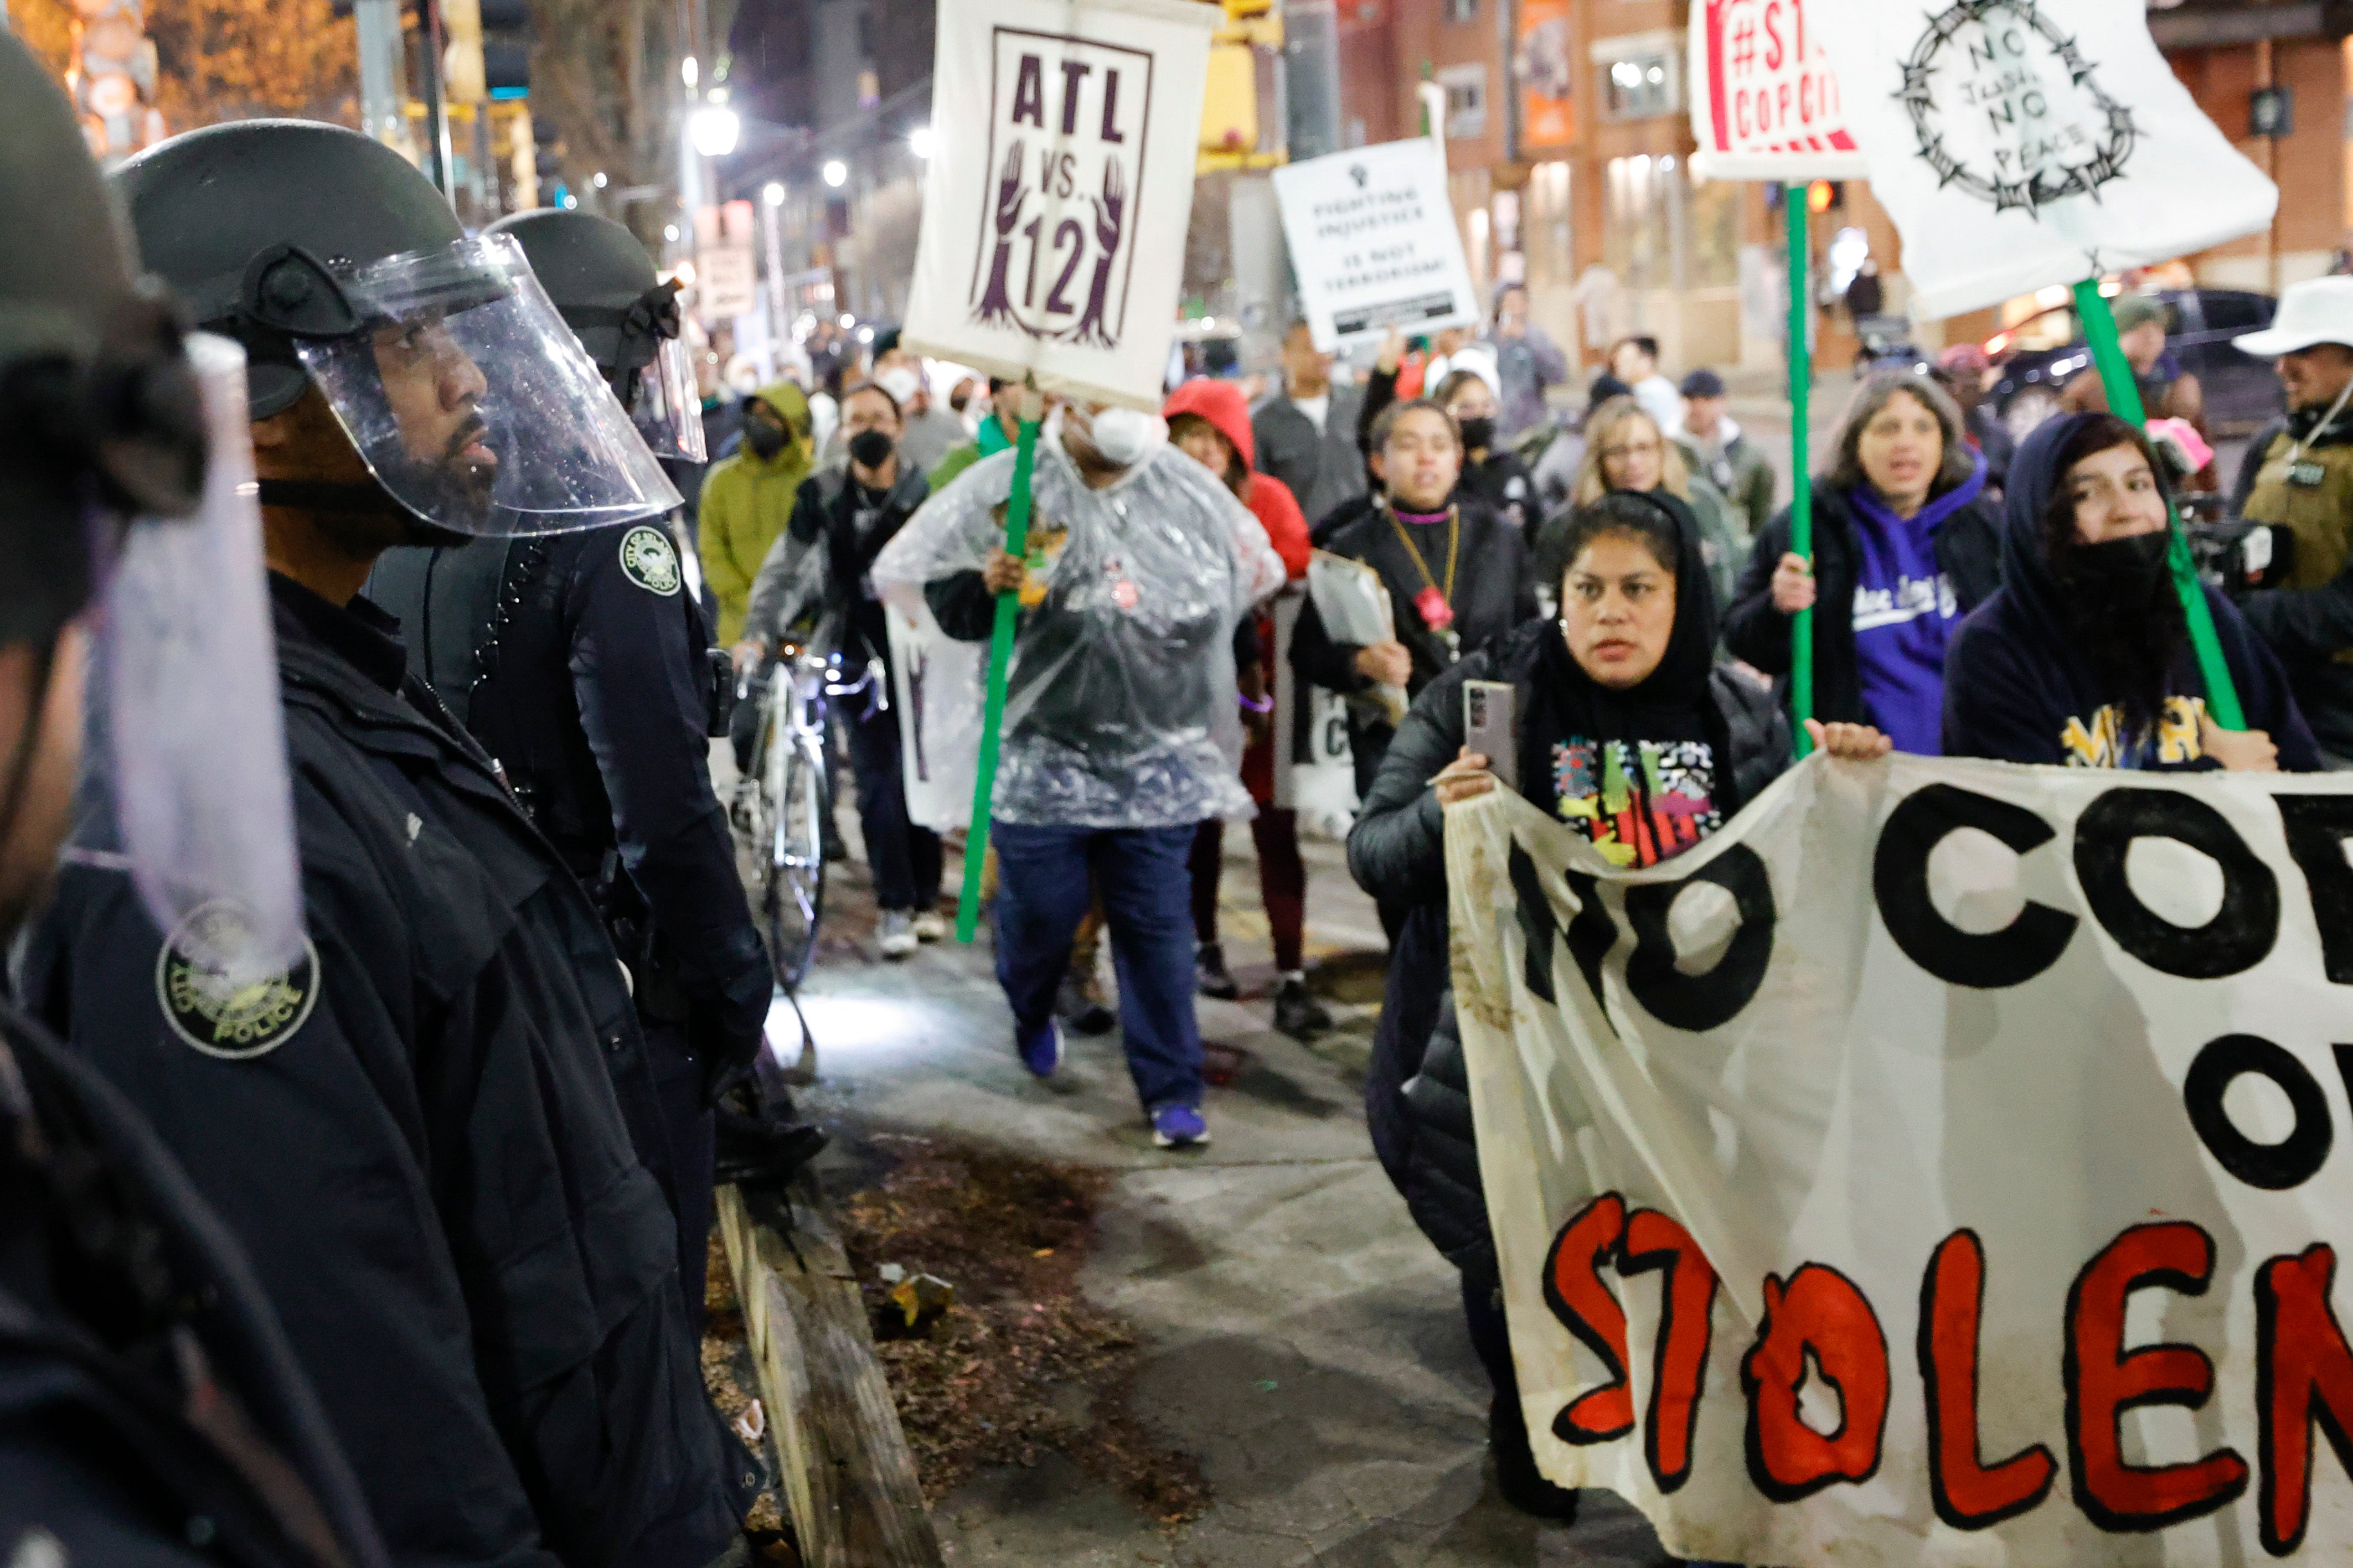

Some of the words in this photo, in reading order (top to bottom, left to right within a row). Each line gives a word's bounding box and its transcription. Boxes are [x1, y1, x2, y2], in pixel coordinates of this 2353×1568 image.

[1733, 0, 1804, 77] #ST
[1012, 54, 1124, 143] ATL
[1988, 90, 2047, 136] NO
[1041, 148, 1087, 201] VS.
[1023, 215, 1087, 315] 12
[1506, 831, 1776, 1039] NO
[213, 987, 304, 1043] POLICE
[2184, 1033, 2353, 1191] O
